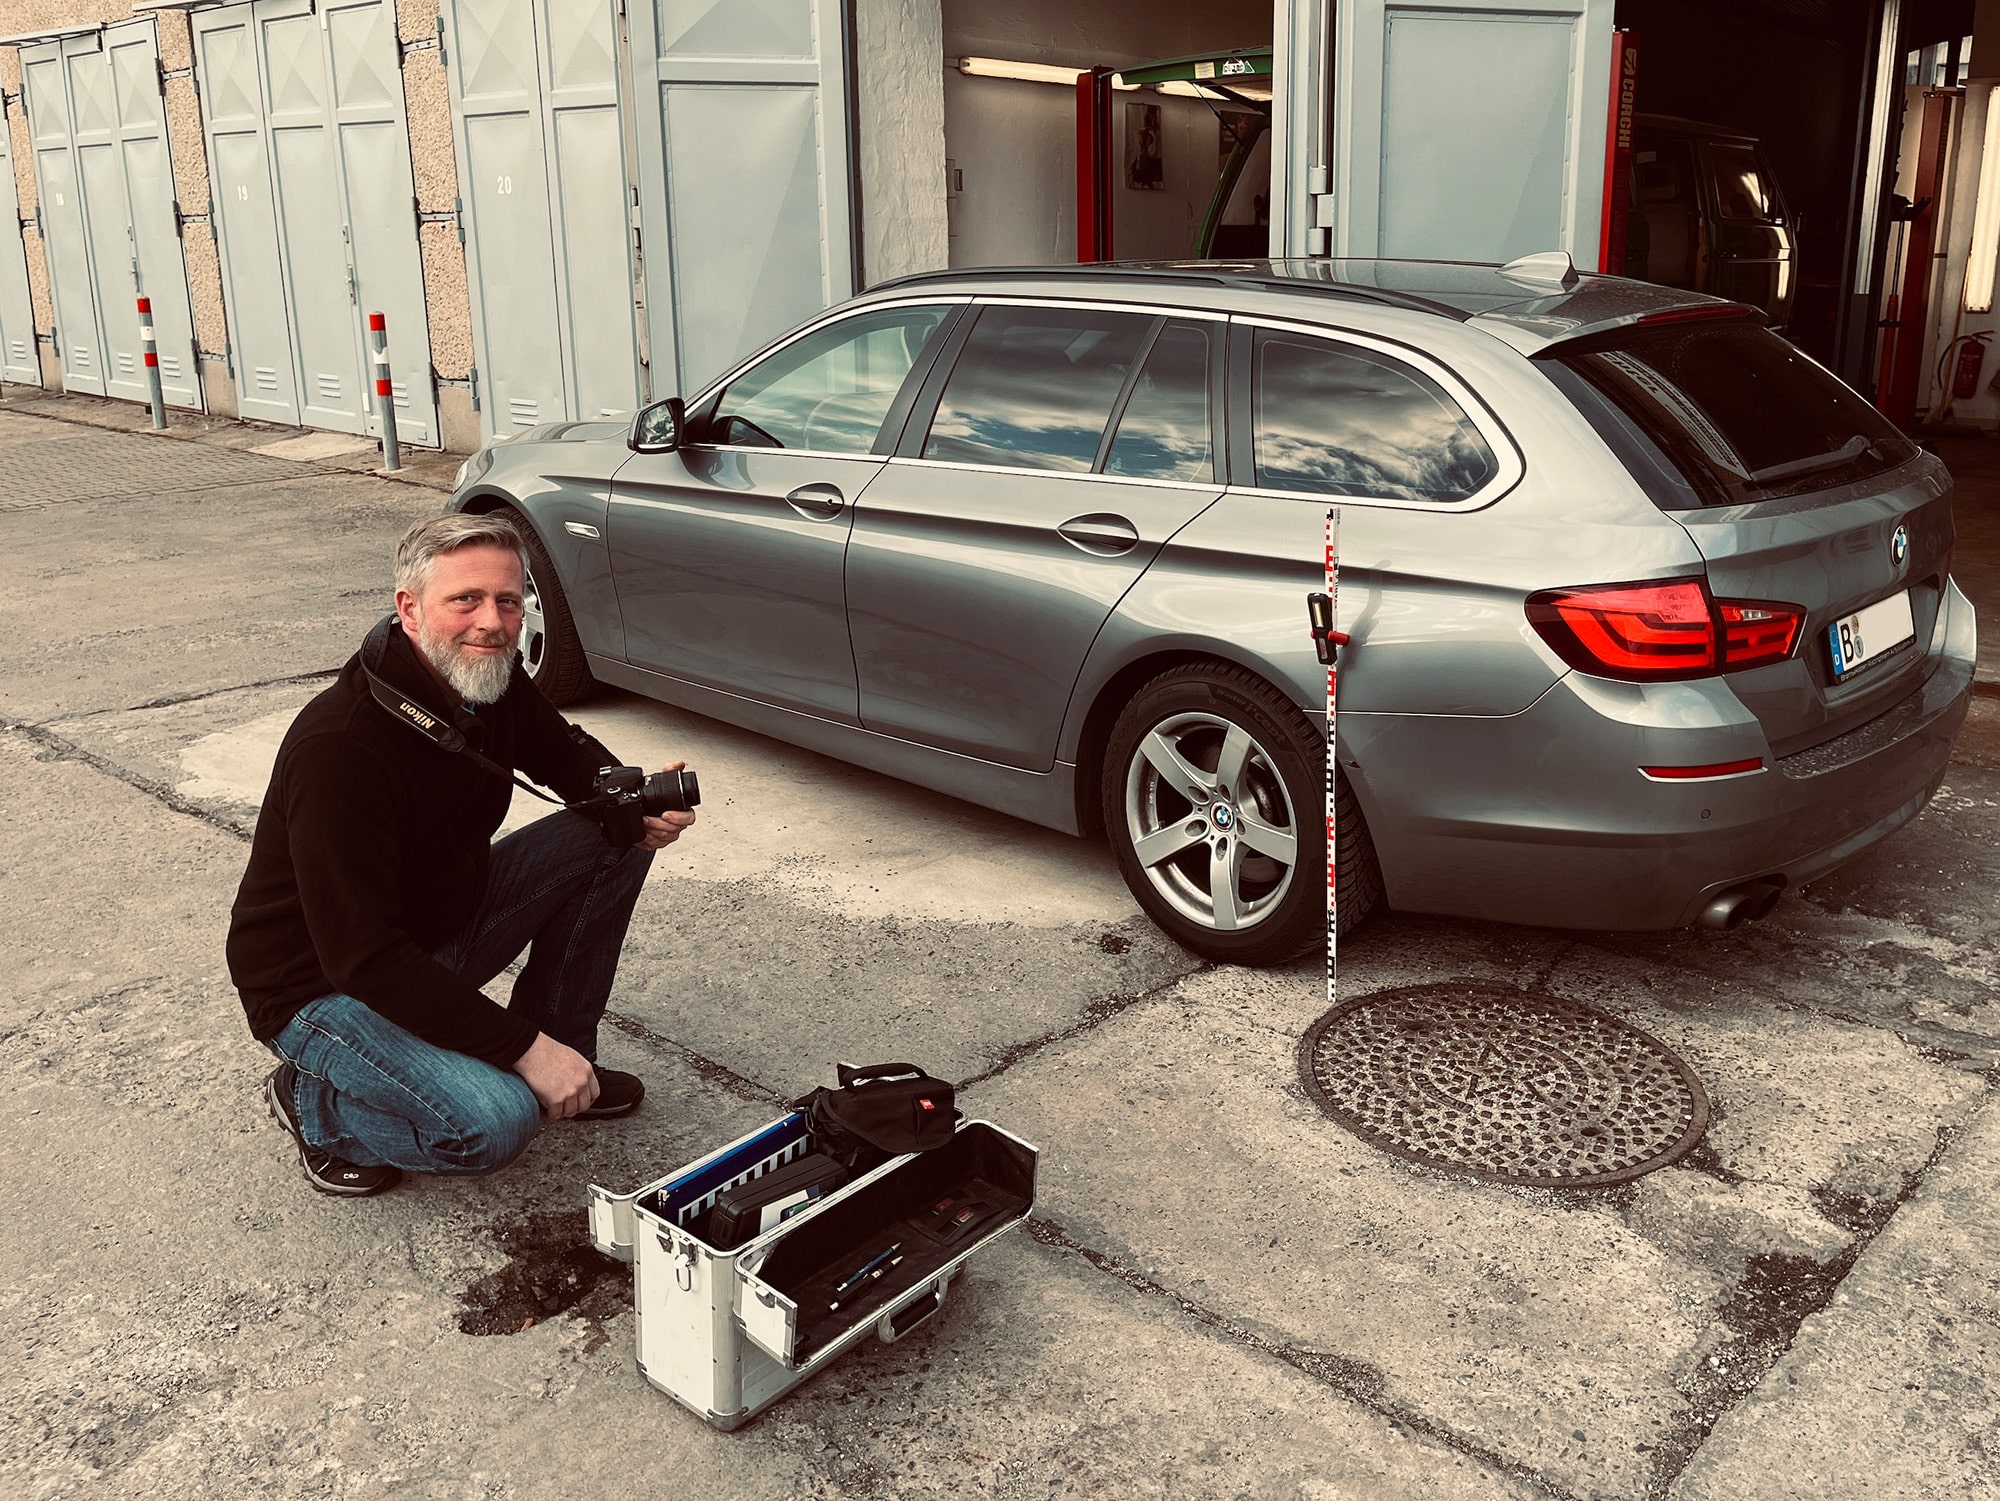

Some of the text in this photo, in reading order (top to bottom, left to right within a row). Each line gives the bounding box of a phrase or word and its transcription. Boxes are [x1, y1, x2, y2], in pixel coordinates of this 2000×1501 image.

[1618, 78, 1635, 148] CORGHI
[237, 185, 248, 201] 19
[496, 175, 512, 195] 20
[1840, 623, 1854, 664] B
[1834, 653, 1840, 666] D
[399, 702, 436, 729] Nikon
